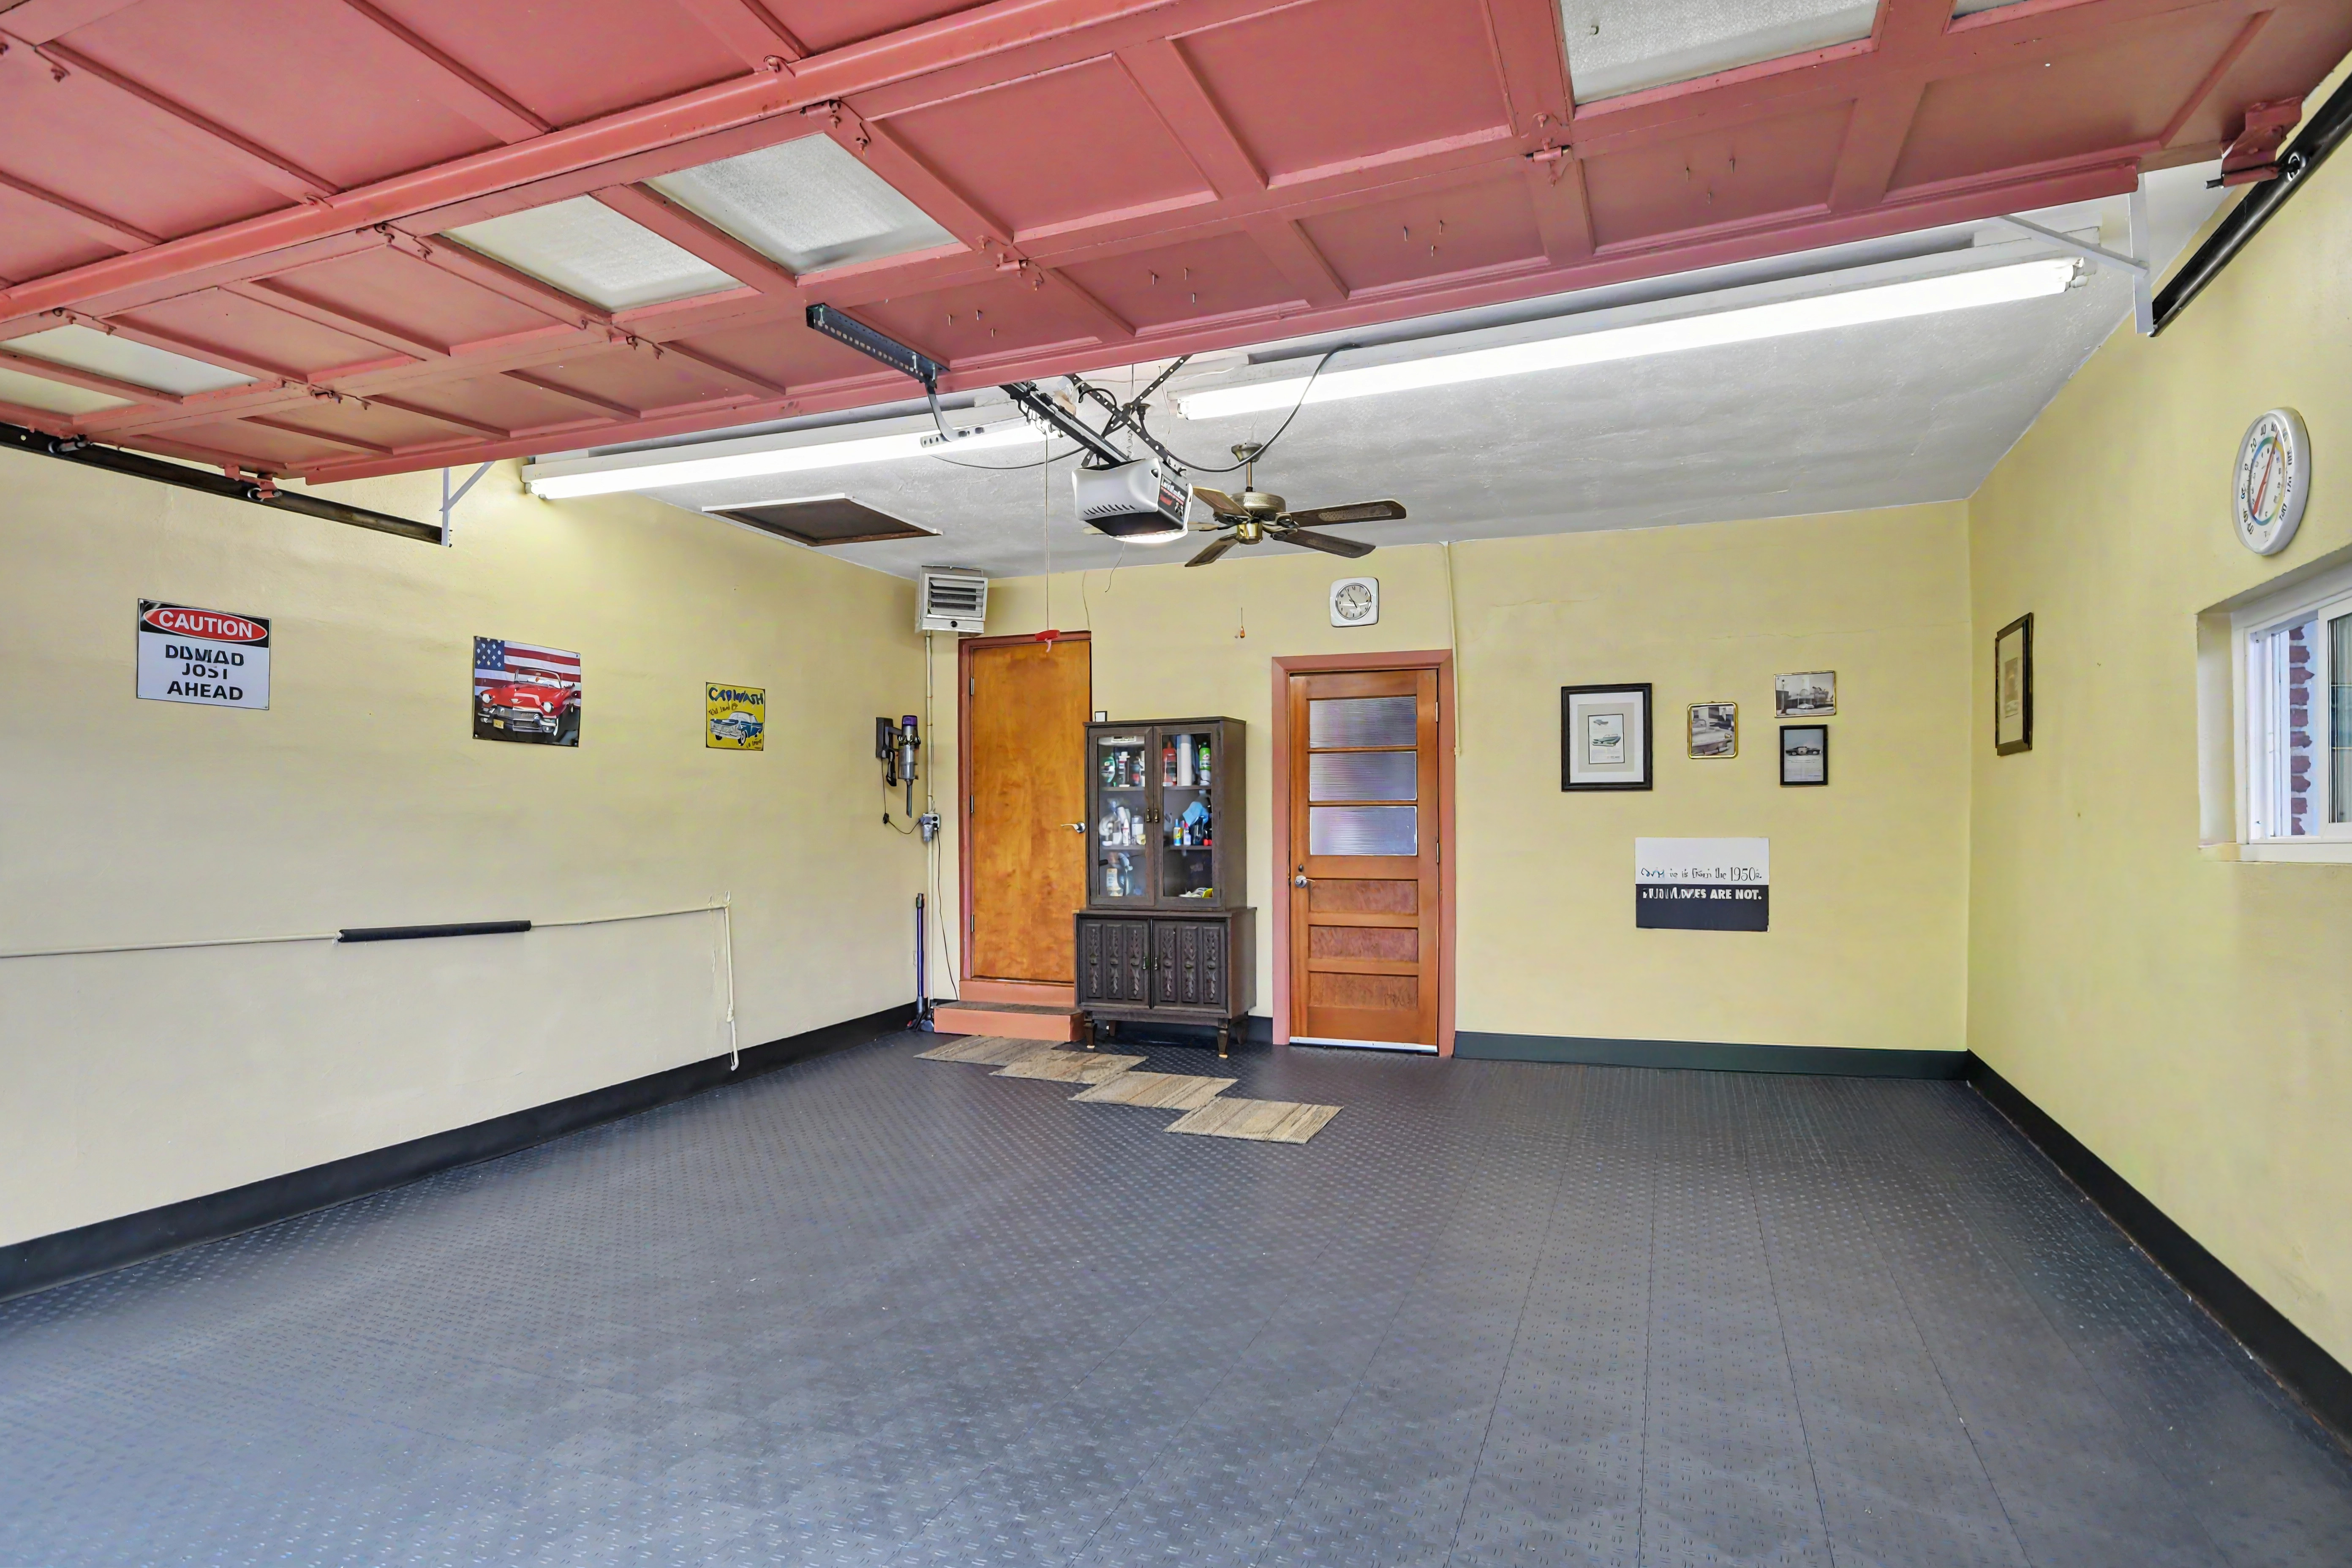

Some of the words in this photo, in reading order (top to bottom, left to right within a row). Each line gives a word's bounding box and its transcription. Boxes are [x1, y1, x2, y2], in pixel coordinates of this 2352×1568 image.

[159, 611, 252, 638] CAUTION
[167, 681, 243, 700] AHEAD
[1710, 889, 1732, 899] ARE
[1735, 889, 1762, 900] NOT.
